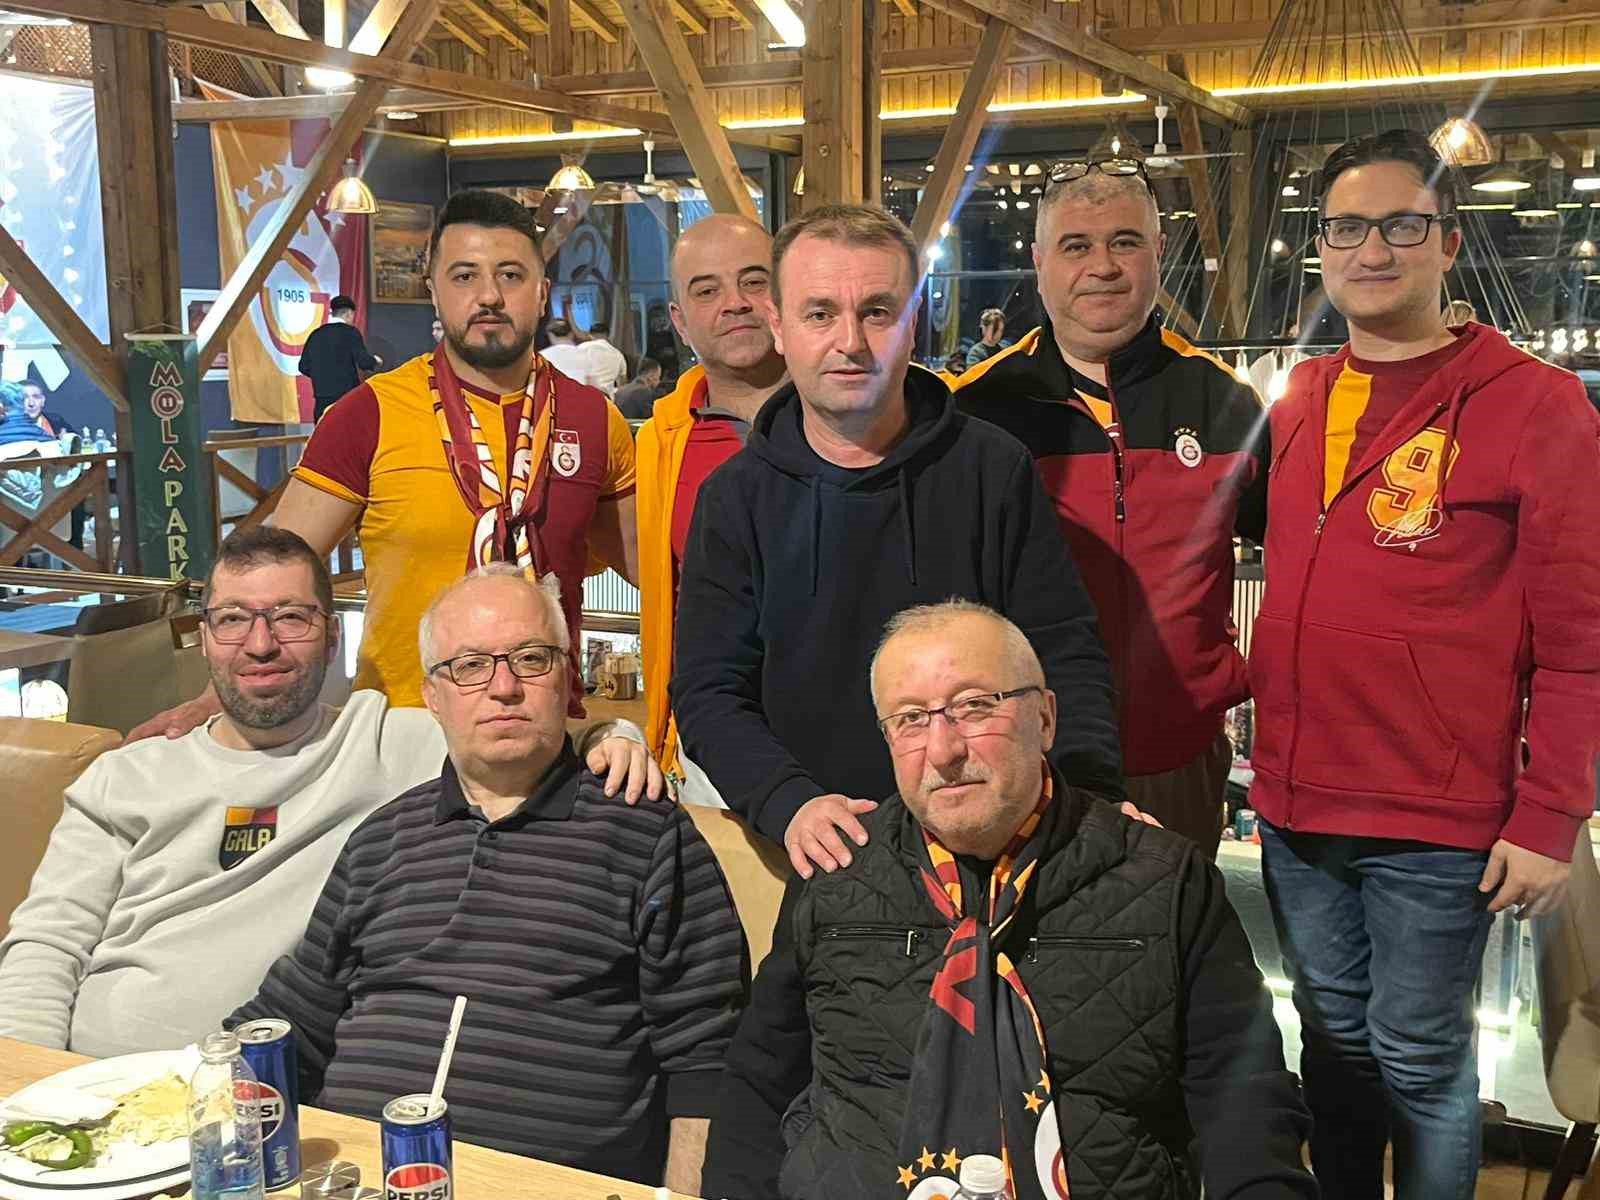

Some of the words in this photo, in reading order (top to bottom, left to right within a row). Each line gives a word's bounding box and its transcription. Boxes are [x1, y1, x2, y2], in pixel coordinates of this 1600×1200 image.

[278, 288, 305, 303] 1905
[149, 361, 186, 472] MOLA
[164, 480, 189, 581] PARK
[1366, 427, 1460, 538] 9
